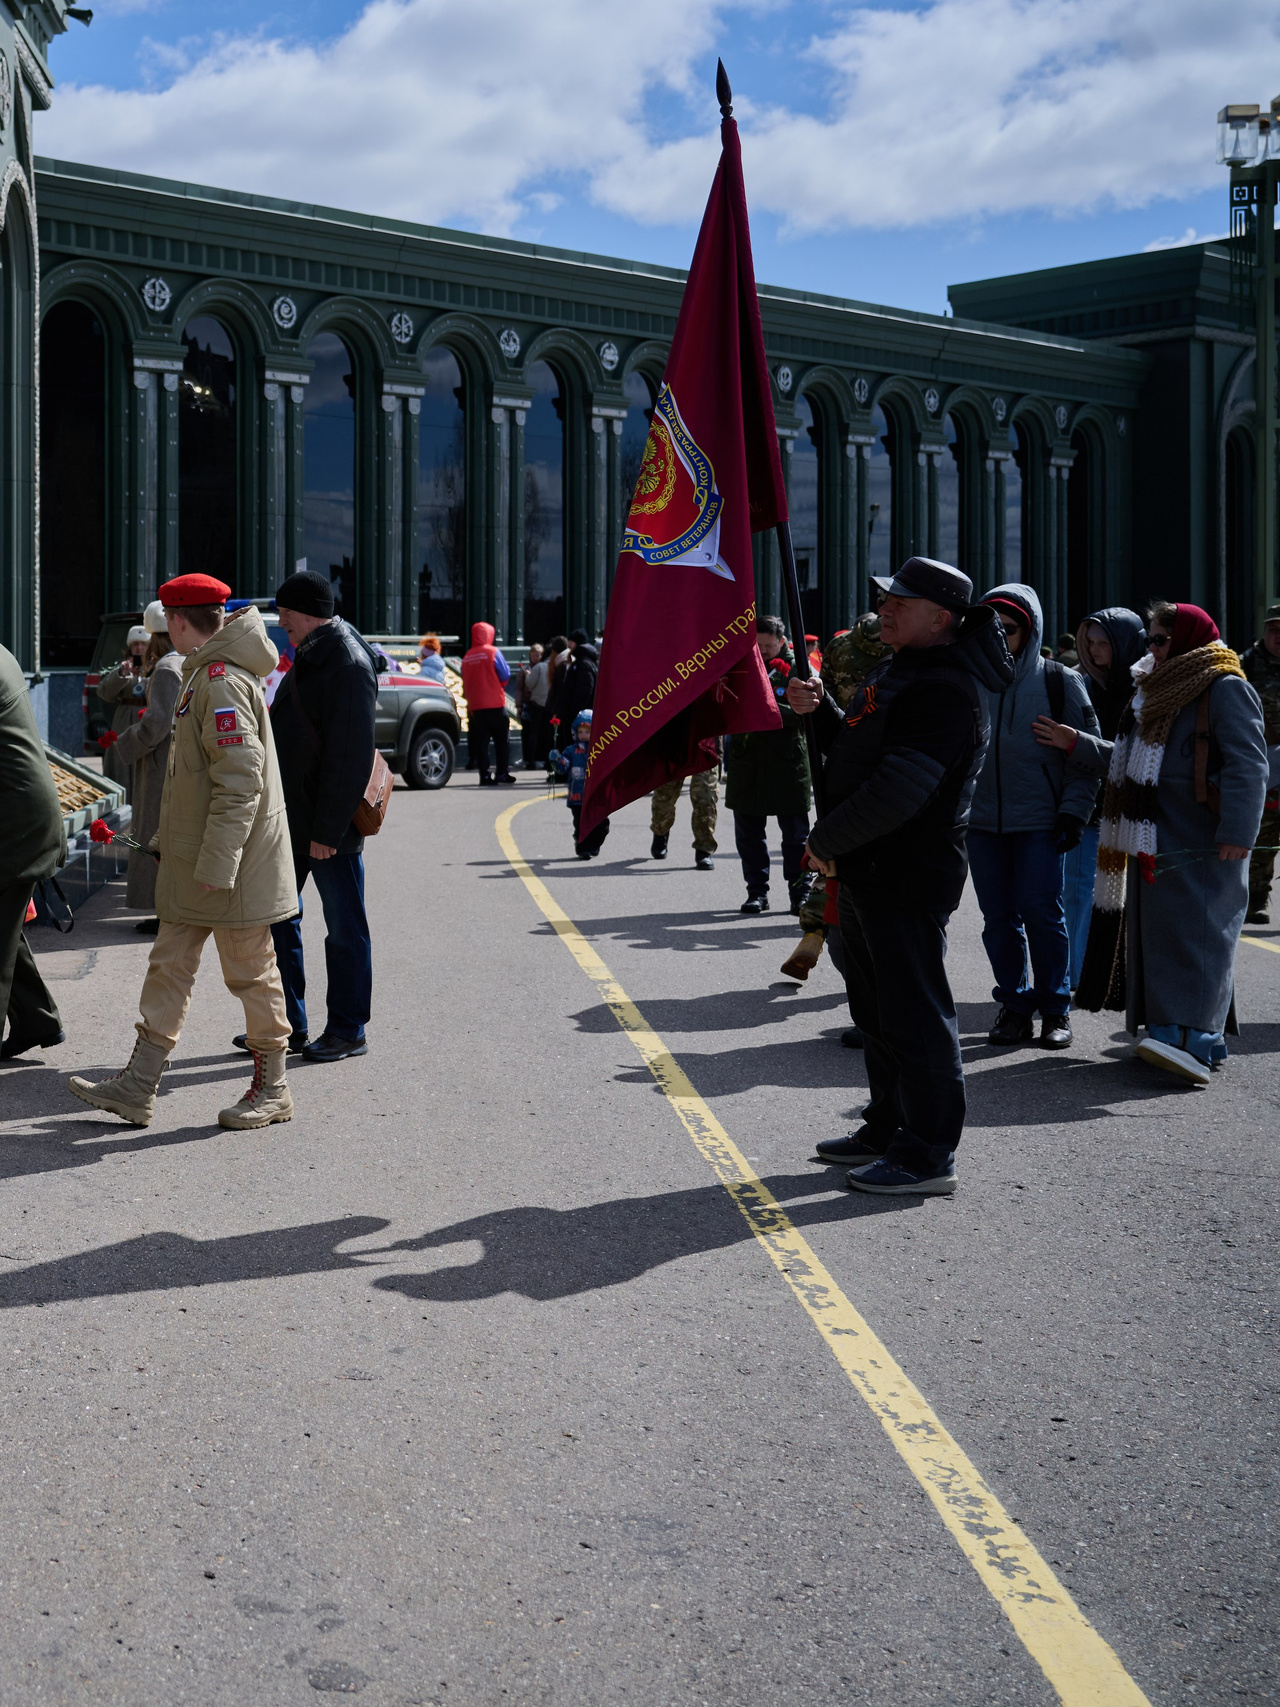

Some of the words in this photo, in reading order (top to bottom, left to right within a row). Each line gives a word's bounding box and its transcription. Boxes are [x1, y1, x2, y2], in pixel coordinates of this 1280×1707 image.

[660, 396, 709, 487] КОНТРРАЗВЕДКА
[623, 537, 634, 548] Я
[650, 543, 680, 561] СОВЕТ
[681, 501, 718, 549] ВЕТЕРАНОВ
[585, 724, 622, 779] ужим
[616, 677, 680, 728] России.
[674, 633, 729, 681] Верны
